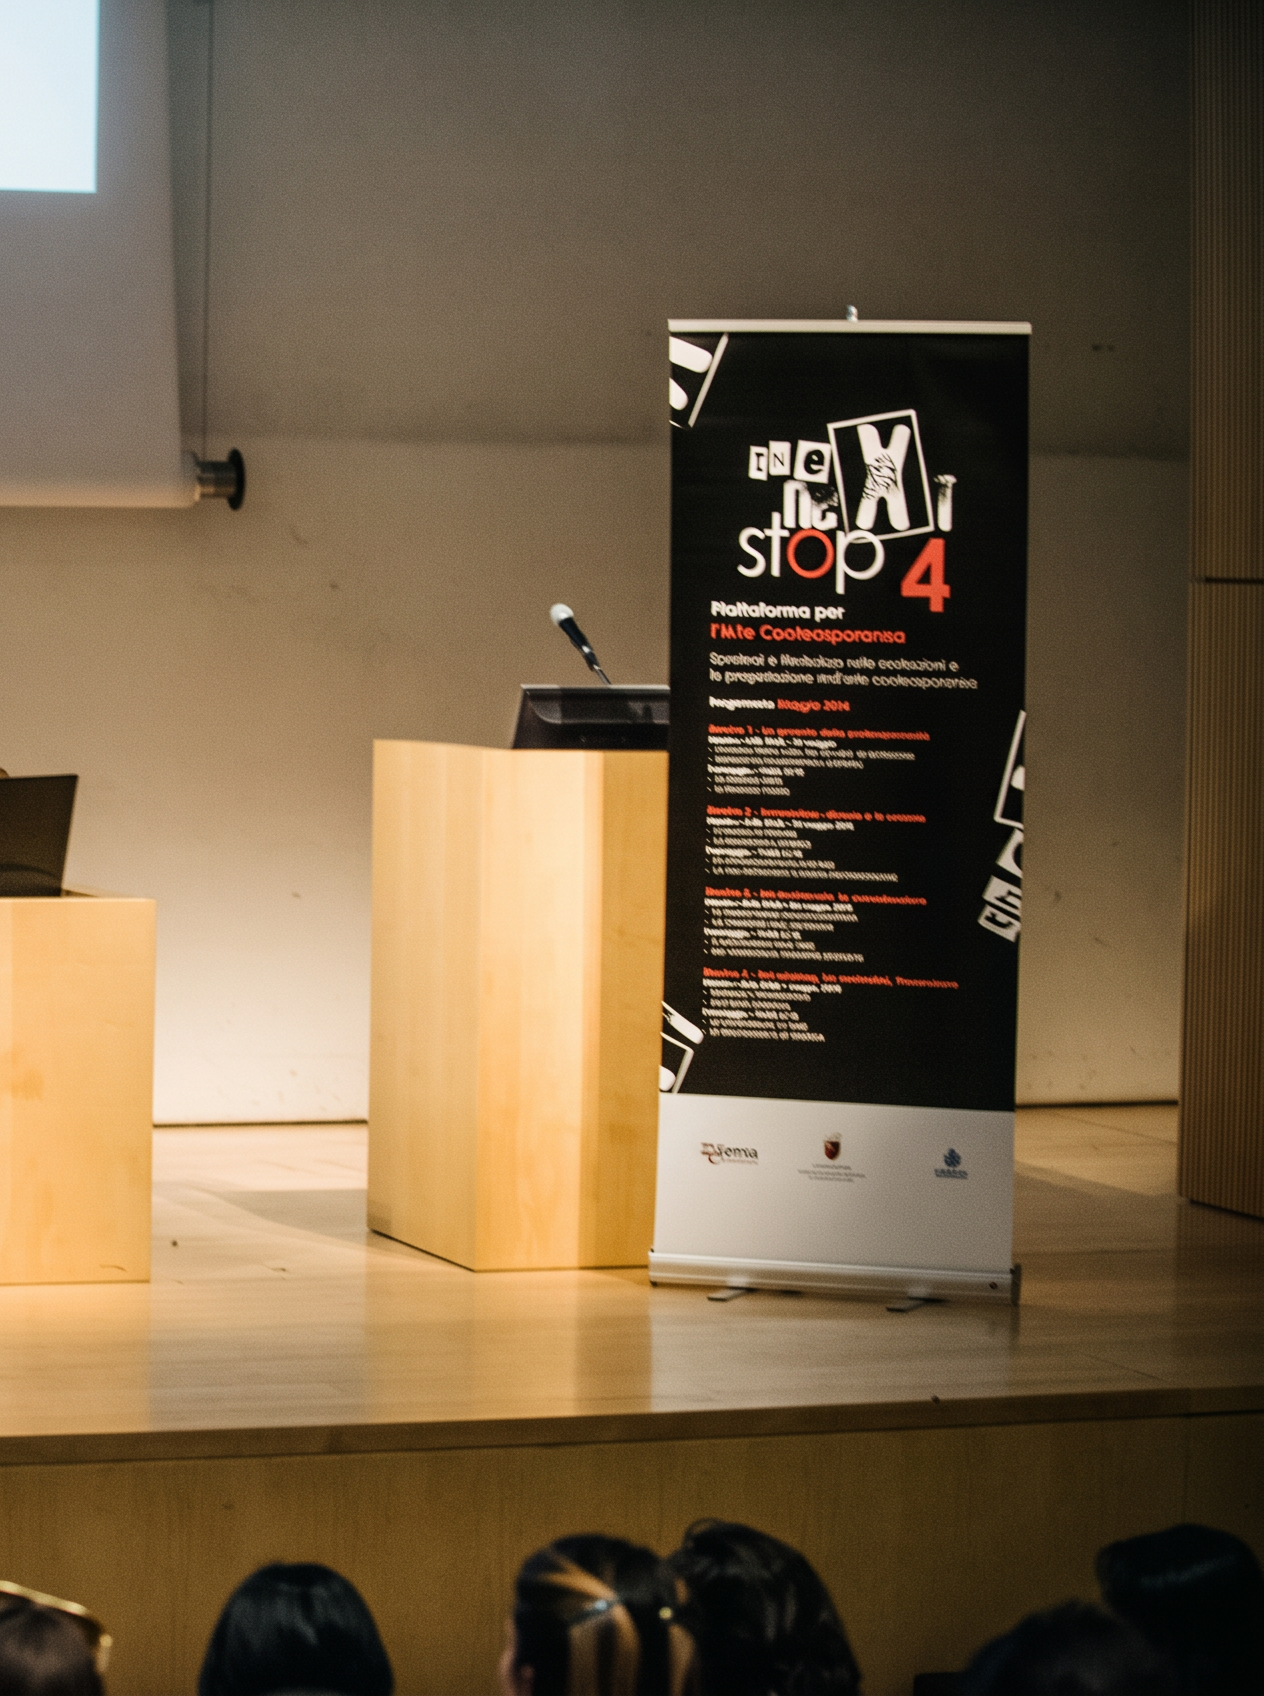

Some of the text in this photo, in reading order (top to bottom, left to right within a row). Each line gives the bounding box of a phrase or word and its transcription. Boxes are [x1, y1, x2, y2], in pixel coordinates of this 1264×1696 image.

[737, 512, 951, 613] stop 4
[814, 605, 846, 622] per
